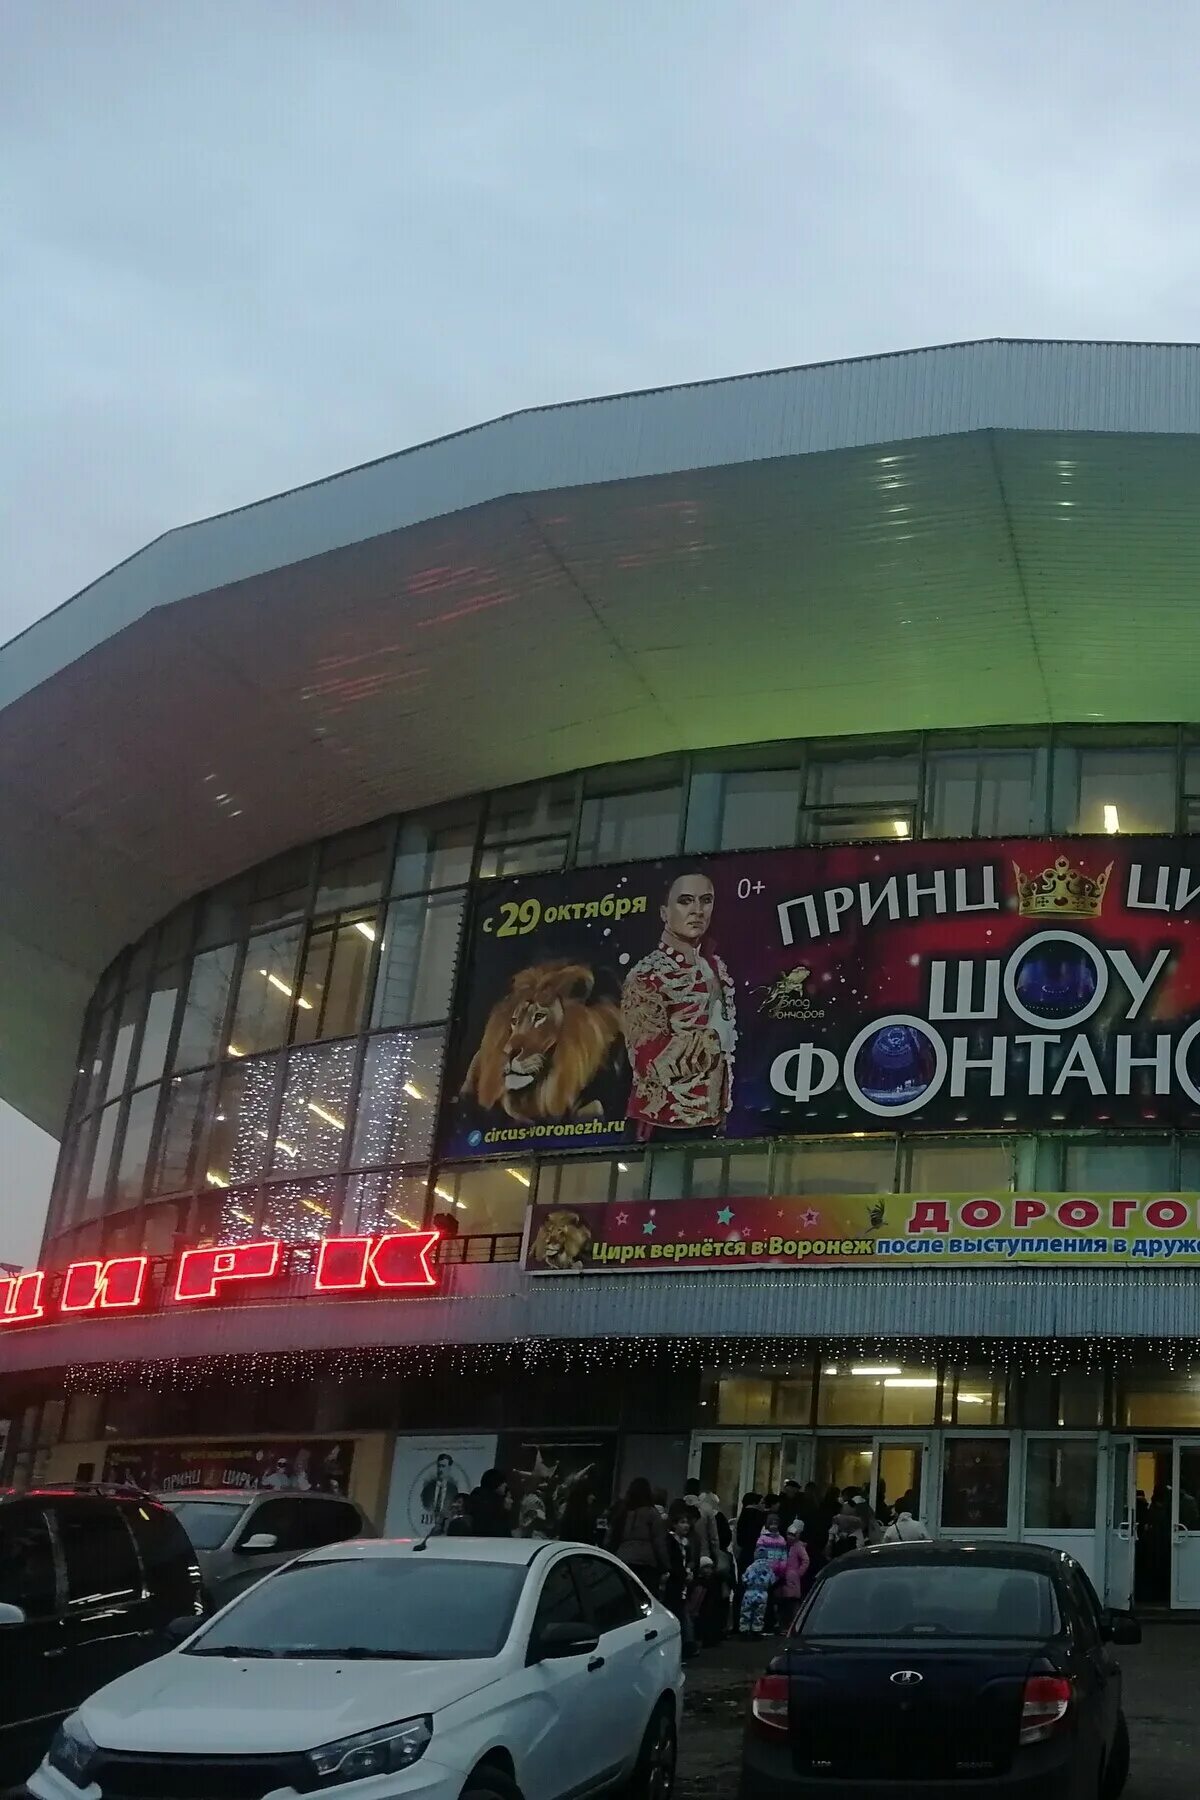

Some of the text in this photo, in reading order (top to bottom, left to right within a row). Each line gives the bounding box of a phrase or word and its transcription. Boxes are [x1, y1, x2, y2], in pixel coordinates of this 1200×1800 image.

[737, 878, 766, 899] 0+
[777, 865, 1000, 945] ПРИНЦ
[482, 894, 647, 938] с 29 октября
[929, 930, 1170, 1030] ШОУ
[484, 1118, 625, 1143] circus-voronezh.ru
[592, 1242, 646, 1263] Цирк
[650, 1238, 746, 1258] вернётся
[769, 1236, 874, 1256] Воронеж
[877, 1240, 944, 1254] после
[948, 1236, 1108, 1256] выступления
[1113, 1240, 1127, 1253] в
